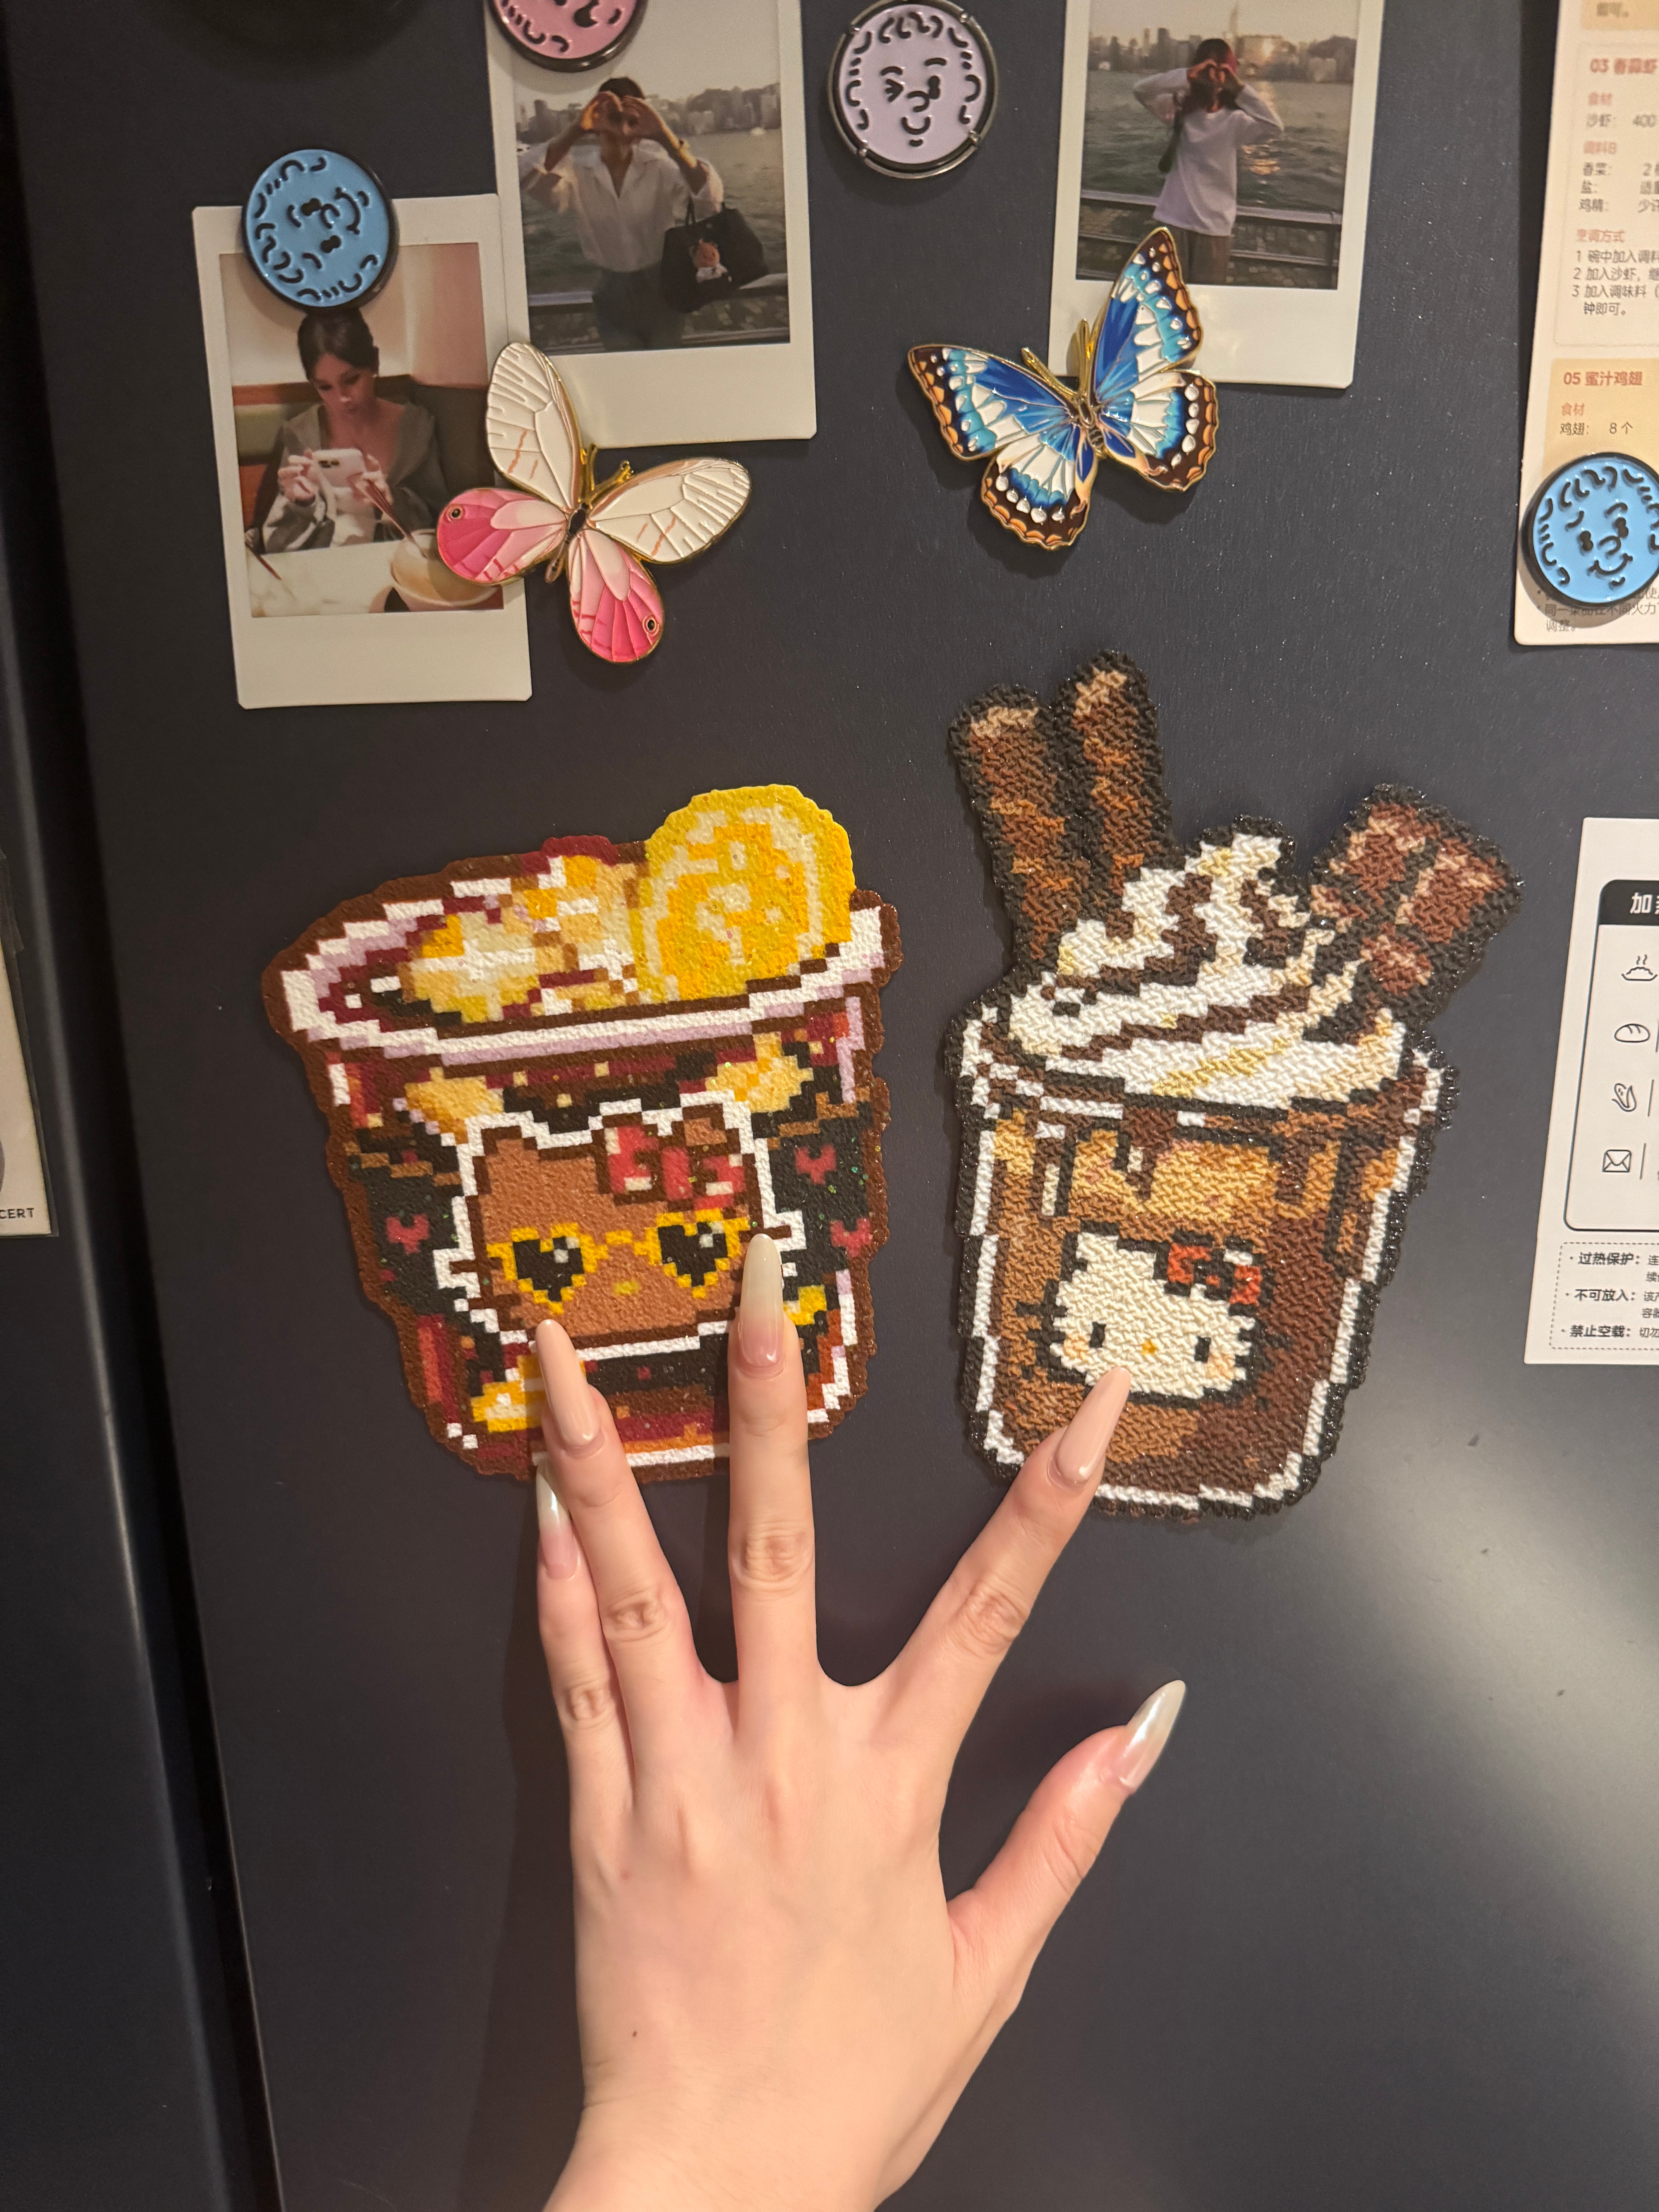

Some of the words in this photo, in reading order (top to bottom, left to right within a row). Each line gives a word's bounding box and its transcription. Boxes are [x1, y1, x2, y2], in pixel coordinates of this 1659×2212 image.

[1642, 163, 1652, 176] 2
[1576, 250, 1581, 262] 1
[1573, 267, 1581, 280] 2
[1571, 285, 1580, 298] 3
[1583, 301, 1626, 316] 钟即可。
[1563, 372, 1581, 385] 05
[1584, 371, 1643, 386] 蜜汁鸡翅
[1561, 402, 1585, 416] 食材
[1559, 422, 1590, 435] 鸡翅：
[1609, 422, 1618, 434] 8
[1621, 422, 1633, 435] 个
[1546, 620, 1575, 632] 调整。
[1578, 1252, 1640, 1266] 过热保护：
[1646, 1271, 1659, 1282] 续
[1574, 1288, 1636, 1302] 不可放入：
[1569, 1324, 1631, 1338] 禁止空载：
